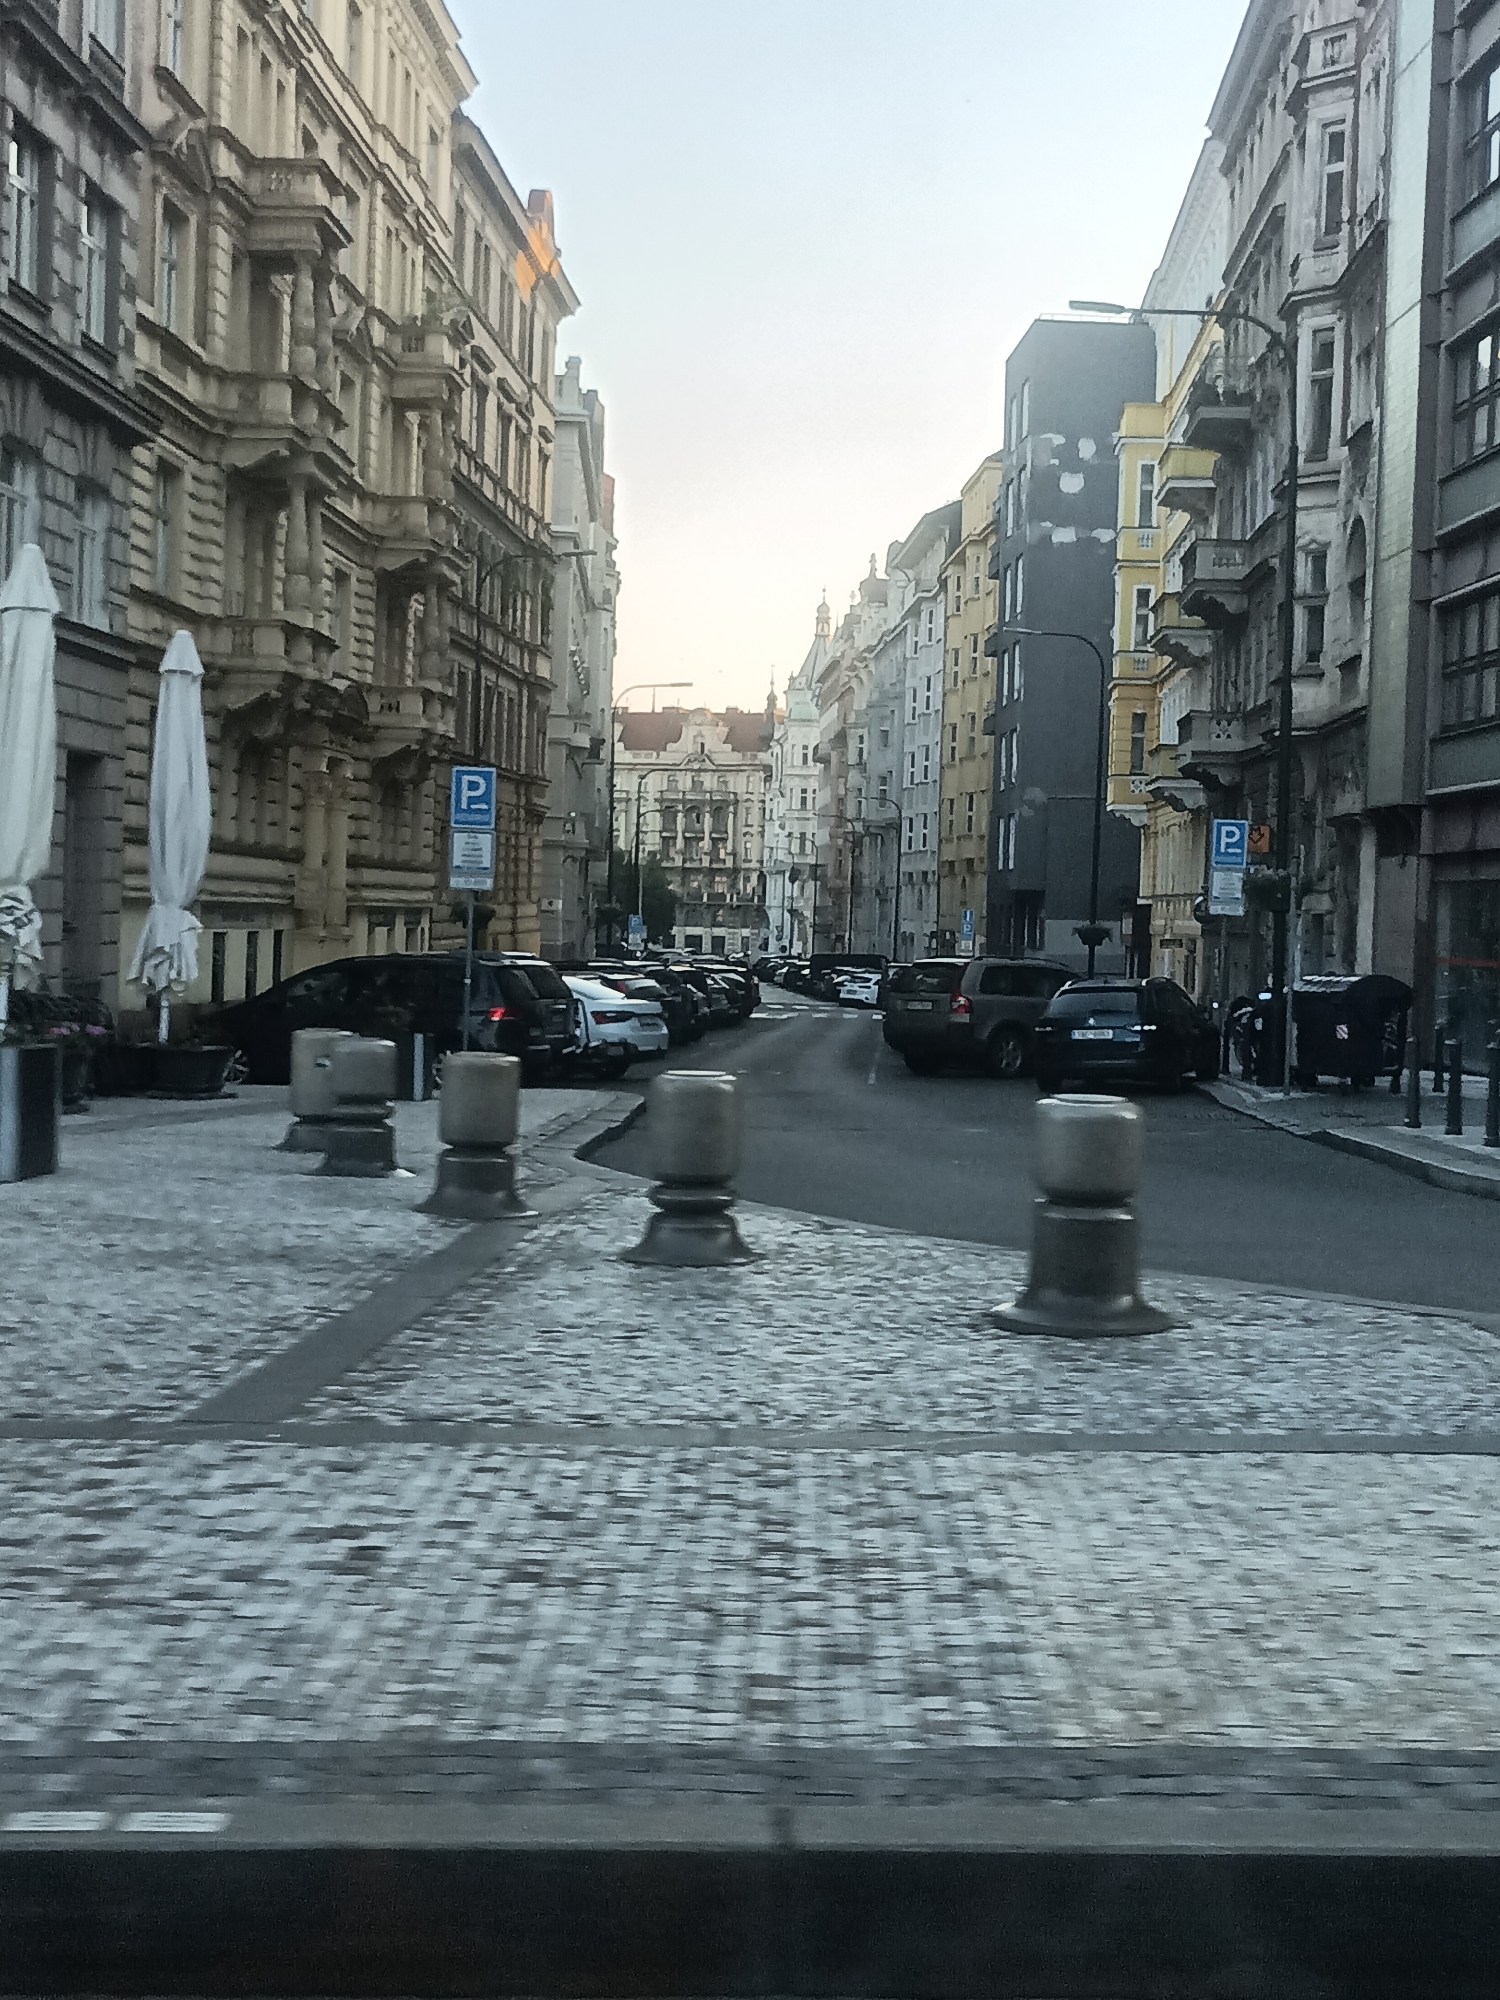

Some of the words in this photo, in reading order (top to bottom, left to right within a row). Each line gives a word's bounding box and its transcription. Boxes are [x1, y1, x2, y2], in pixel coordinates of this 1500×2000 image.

[461, 775, 487, 810] P
[1220, 825, 1240, 853] P
[963, 923, 971, 934] P
